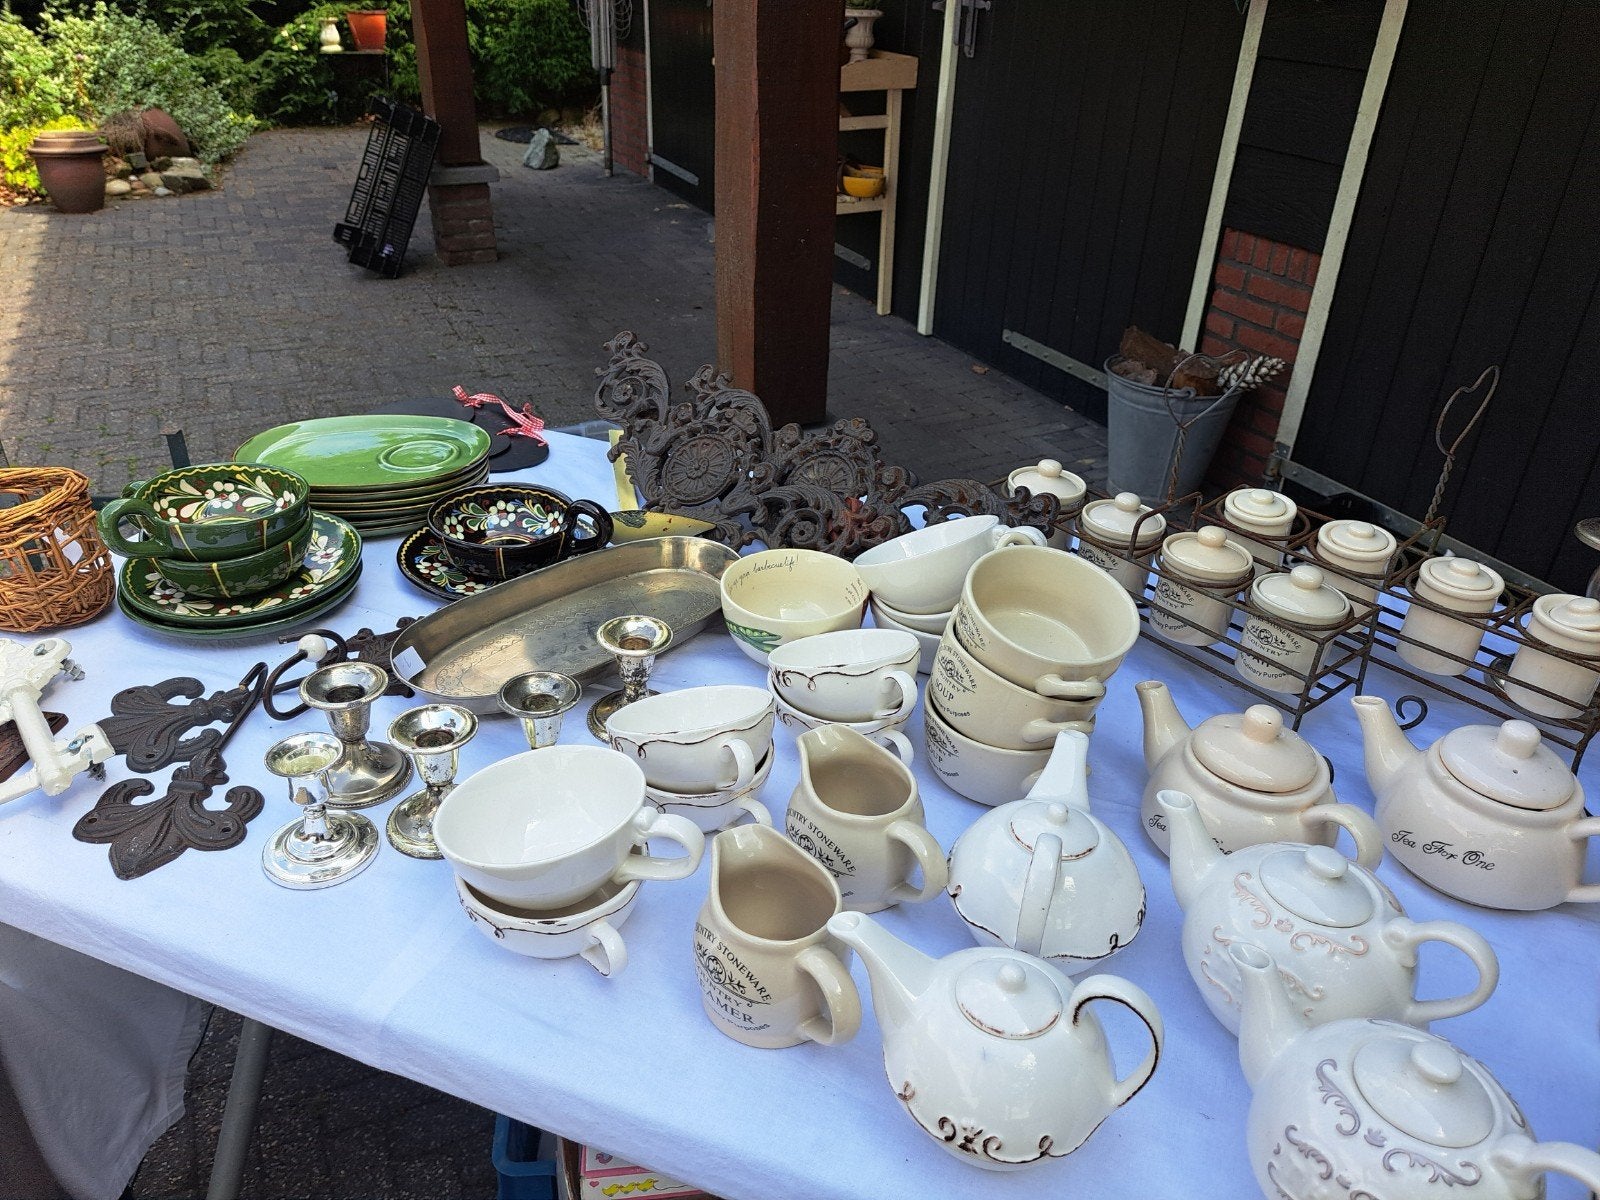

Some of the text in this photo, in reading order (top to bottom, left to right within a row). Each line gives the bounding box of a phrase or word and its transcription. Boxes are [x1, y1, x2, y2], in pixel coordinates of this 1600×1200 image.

[807, 820, 857, 873] STONEWARE
[1148, 814, 1167, 832] Tea
[1391, 829, 1496, 871] Tea For One
[716, 941, 772, 1002] STONEWARE
